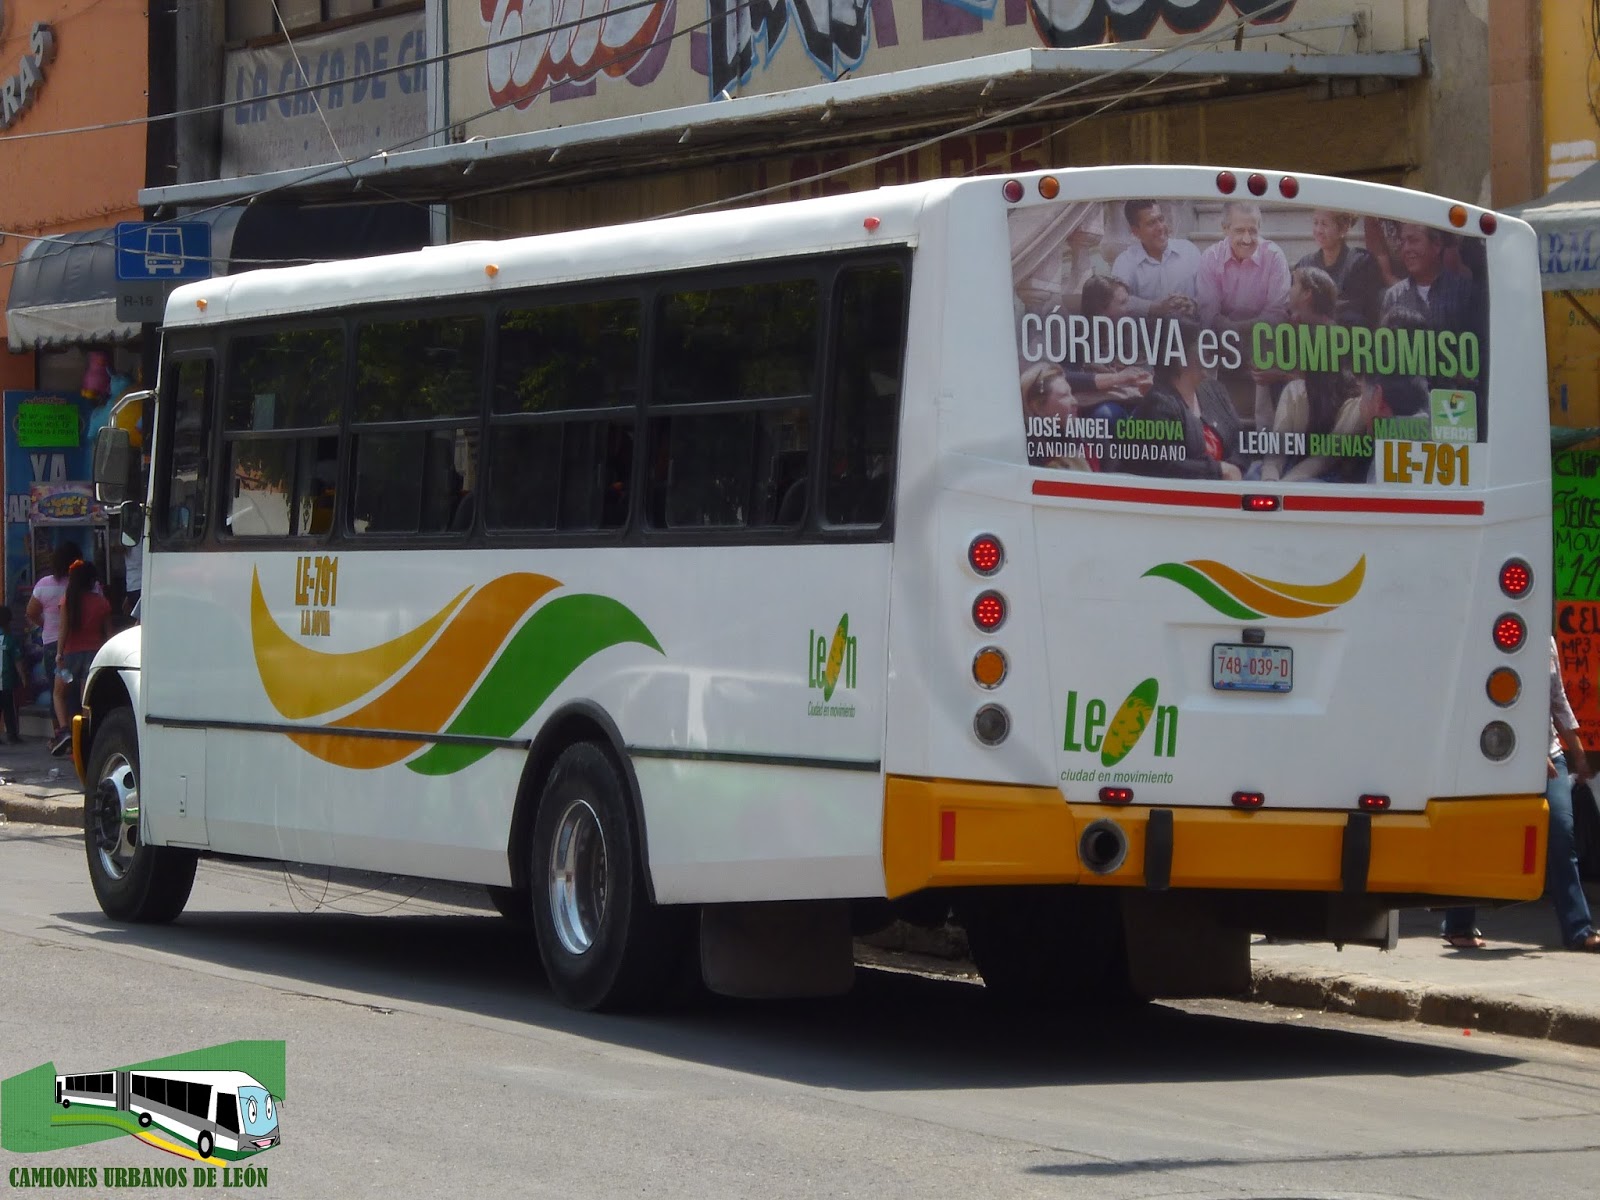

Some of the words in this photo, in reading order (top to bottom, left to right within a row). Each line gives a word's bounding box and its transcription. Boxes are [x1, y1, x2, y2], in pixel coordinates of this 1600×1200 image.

[0, 22, 53, 130] RAS
[235, 64, 268, 125] LA
[278, 49, 345, 117] CASA
[352, 35, 389, 104] DE
[1021, 305, 1187, 367] CÓRDOVA
[1198, 329, 1242, 369] es
[1252, 322, 1480, 379] COMPROMISO
[1026, 414, 1062, 438] JOSÉ
[1065, 414, 1114, 440] ÁNGEL
[1116, 416, 1184, 441] CÓRDOVA
[1434, 426, 1476, 441] VERDE
[1027, 441, 1104, 460] CANDIDATO
[1109, 443, 1187, 462] CIUDADANO
[1239, 428, 1280, 455] LEÓN
[1285, 432, 1306, 456] EN
[1310, 433, 1372, 458] BUENAS
[1383, 441, 1469, 486] LE-791
[295, 556, 338, 607] LE-791
[1218, 656, 1288, 678] 748-039-D
[808, 701, 823, 716] Ciudad
[823, 706, 829, 716] en
[830, 703, 856, 718] movimiento
[1060, 769, 1095, 782] ciudad
[1098, 772, 1111, 782] en
[1113, 771, 1174, 784] movimiento
